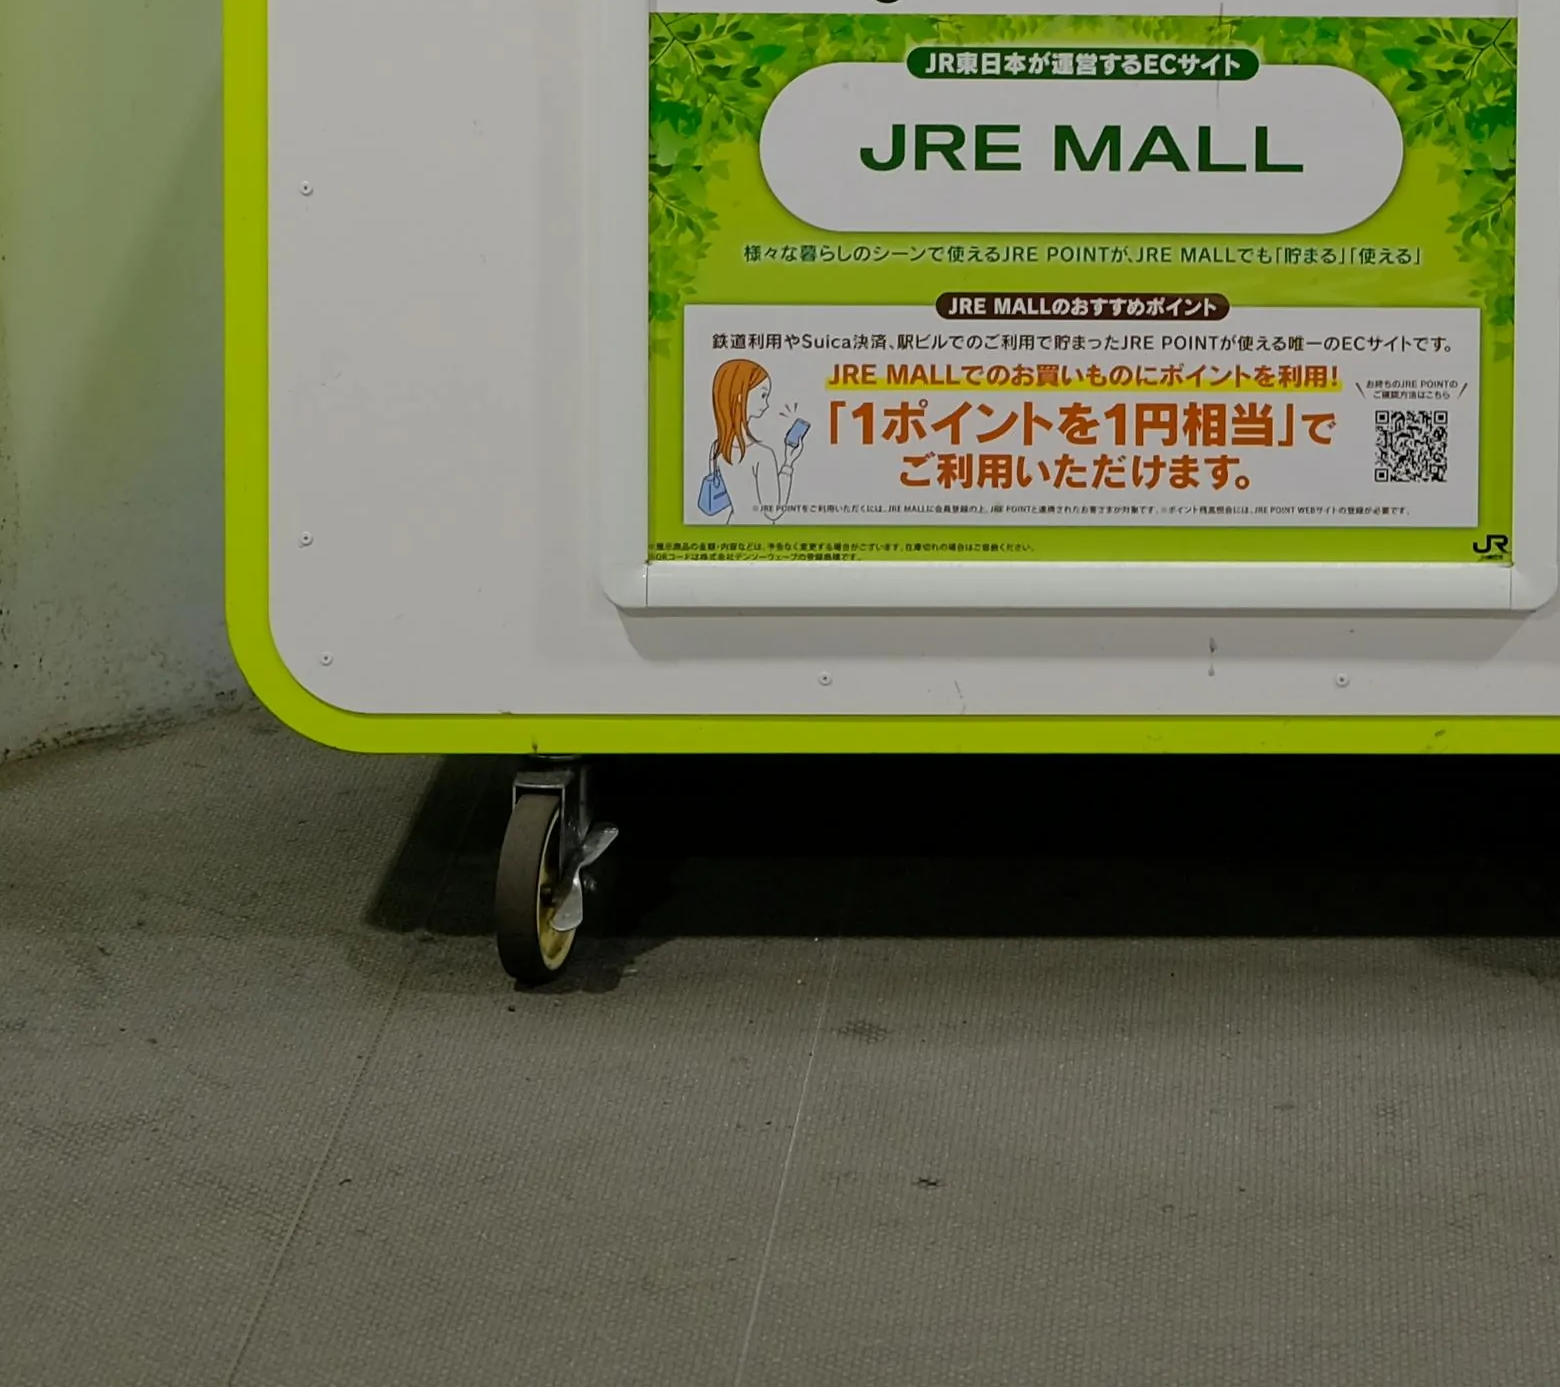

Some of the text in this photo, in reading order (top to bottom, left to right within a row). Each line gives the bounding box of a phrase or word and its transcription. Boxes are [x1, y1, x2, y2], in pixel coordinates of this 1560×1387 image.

[925, 52, 1241, 76] JR東日本が運営するECサイト
[859, 124, 1304, 173] JRE MALL
[949, 297, 1217, 317] JRE MALLのおすすめポイント
[828, 365, 876, 384] JRE
[829, 399, 1337, 447] 「1ポイントを1円相当」で
[900, 451, 1251, 490] ご利用いただけます。
[1473, 535, 1508, 553] JR
